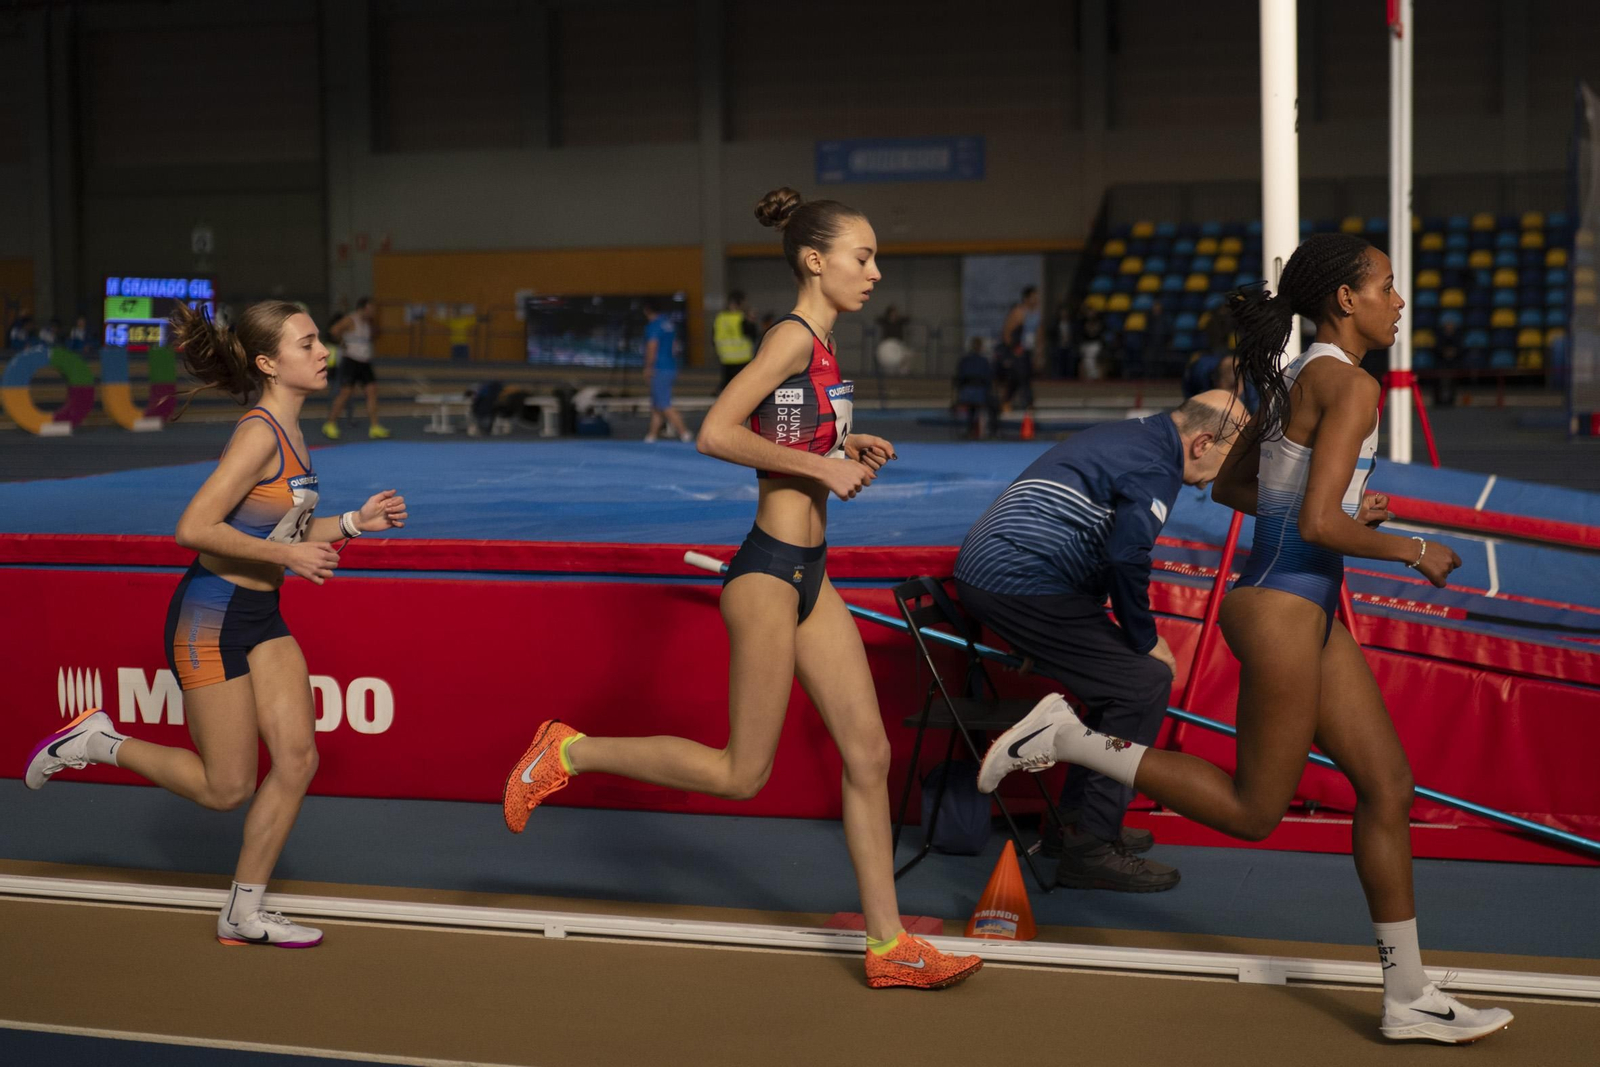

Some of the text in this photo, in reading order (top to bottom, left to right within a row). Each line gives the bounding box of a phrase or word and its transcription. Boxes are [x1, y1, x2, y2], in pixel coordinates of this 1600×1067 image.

[777, 407, 788, 421] DE
[789, 407, 801, 444] XUNTA
[117, 666, 395, 735] MDO
[981, 909, 1020, 922] MONDO
